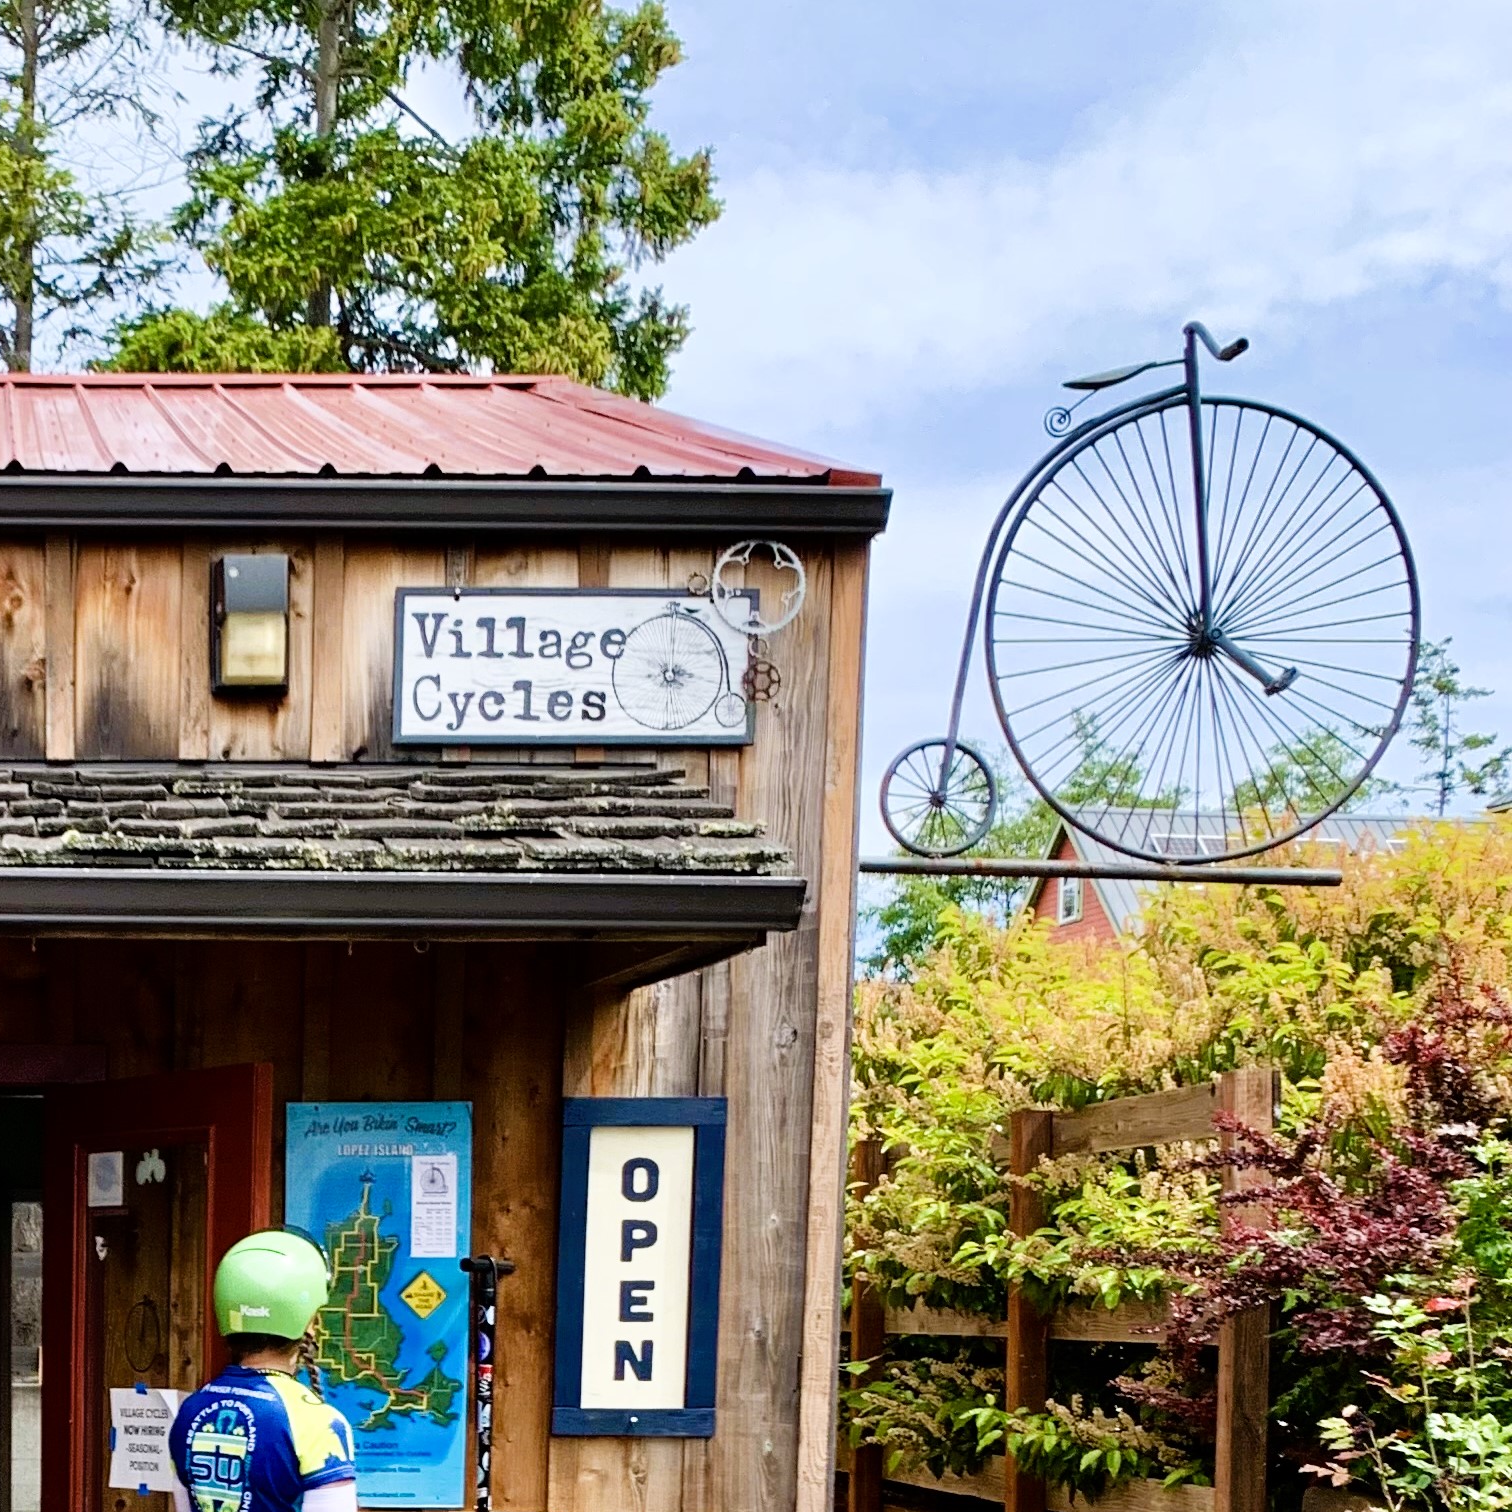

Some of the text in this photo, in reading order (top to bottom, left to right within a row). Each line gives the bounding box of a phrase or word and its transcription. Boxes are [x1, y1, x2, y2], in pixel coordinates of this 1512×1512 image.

[411, 612, 628, 669] Village
[412, 673, 607, 731] Cycles
[333, 1116, 359, 1137] You
[405, 1116, 457, 1138] Smart?
[339, 1144, 414, 1156] LOPEZ ISLAND
[613, 1157, 660, 1382] OPEN
[119, 1408, 144, 1419] VILLAGE
[124, 1425, 140, 1435] NOW
[129, 1460, 160, 1472] POSITION
